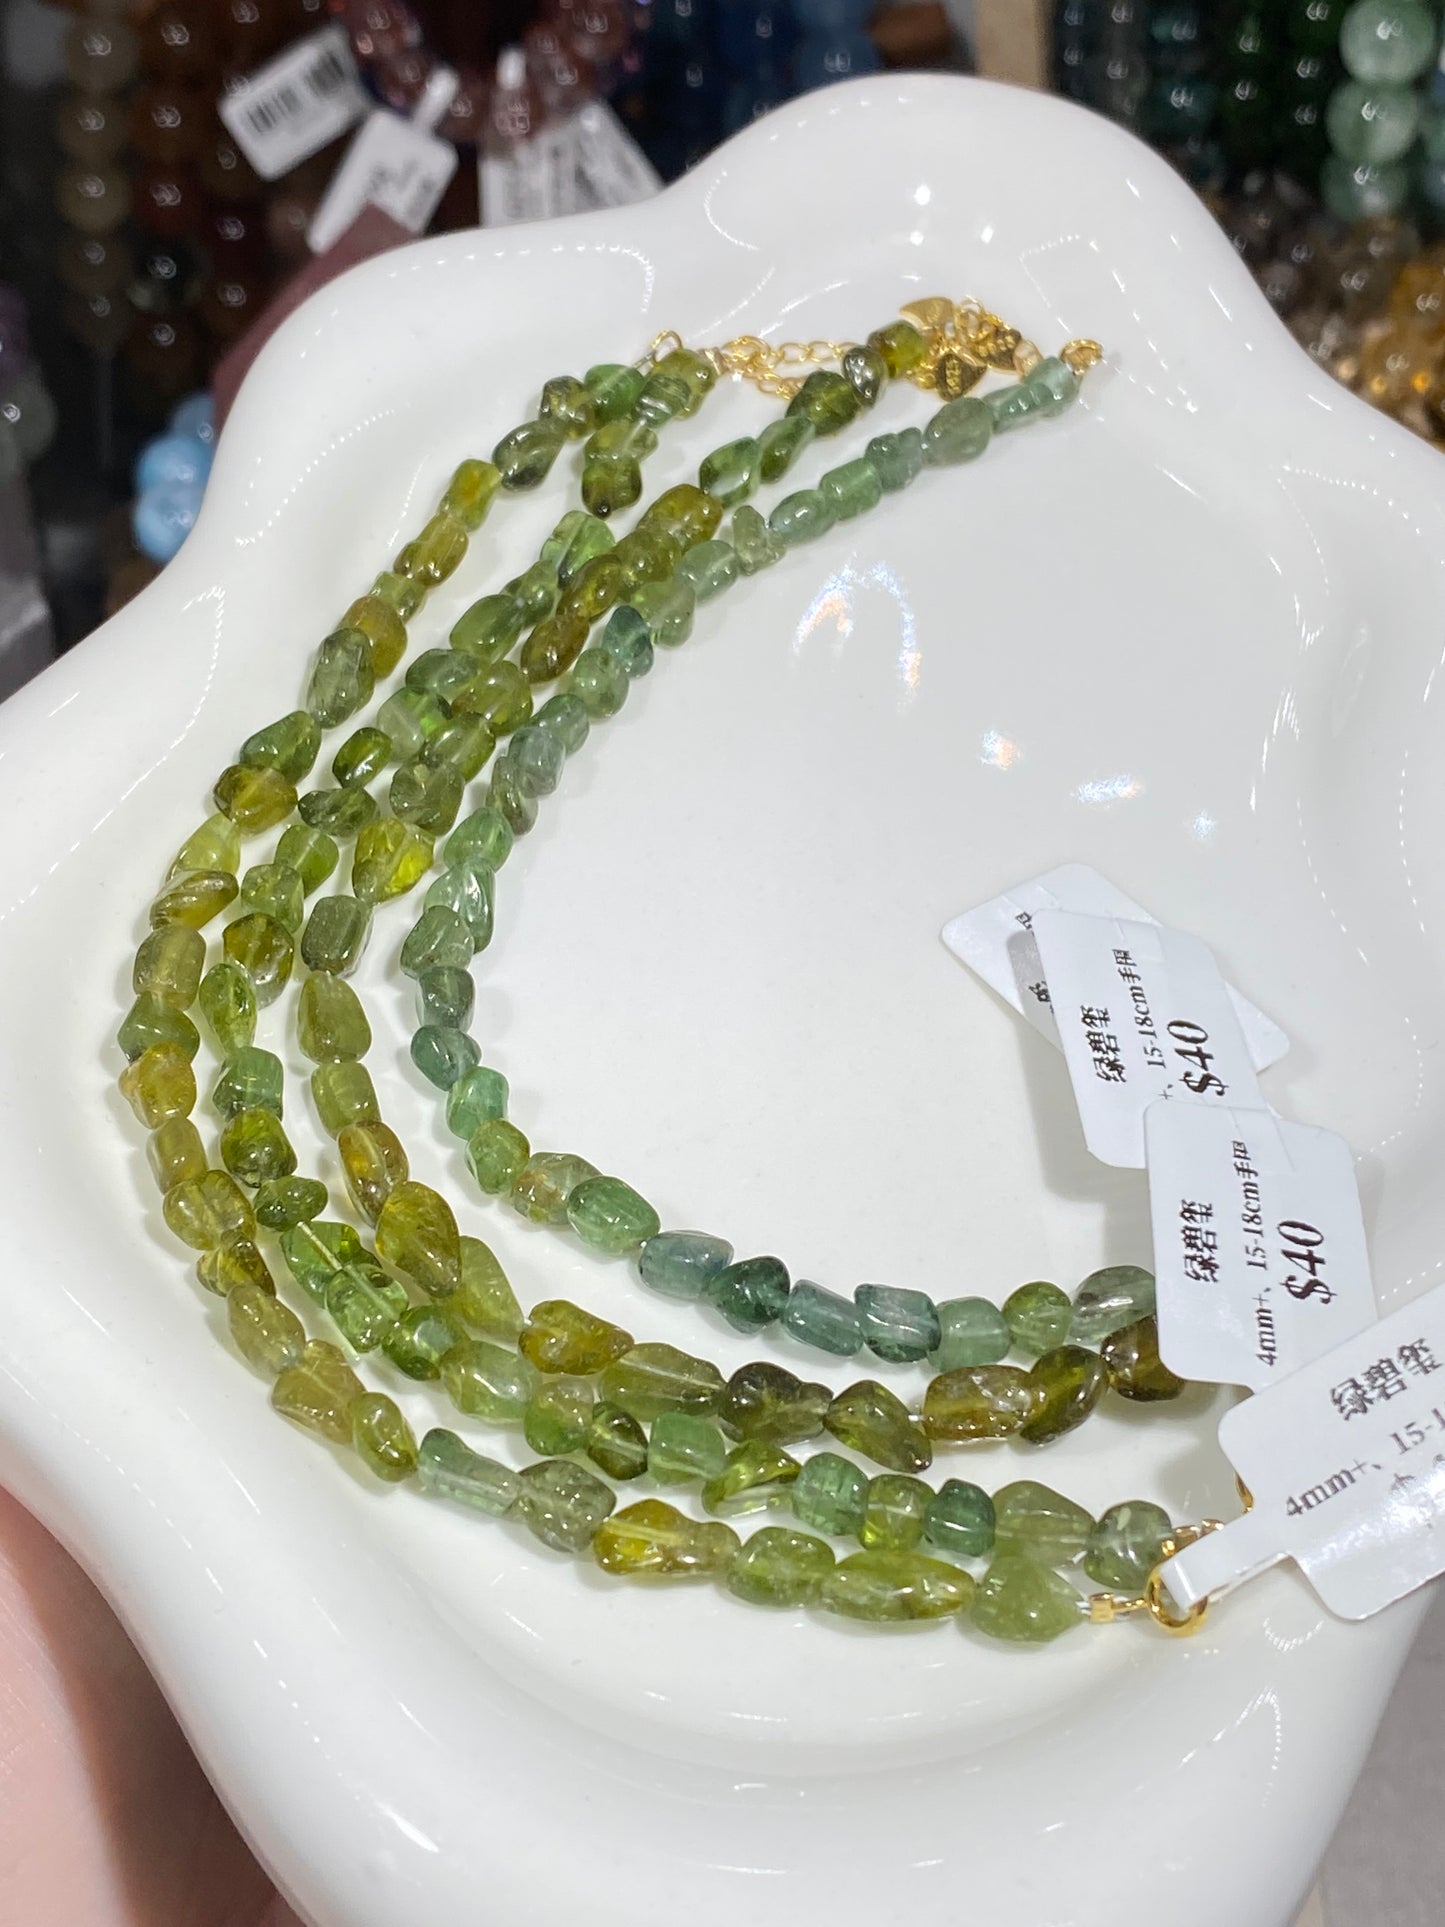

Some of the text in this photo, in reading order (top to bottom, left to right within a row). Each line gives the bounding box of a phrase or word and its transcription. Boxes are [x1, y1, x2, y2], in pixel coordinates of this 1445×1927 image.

[1079, 1005, 1127, 1083] 绿碧玺
[1166, 1018, 1229, 1097] $40
[1179, 1198, 1220, 1283] 绿碧玺
[1275, 1219, 1338, 1305] $40
[1329, 1337, 1443, 1421] 绿碧玺
